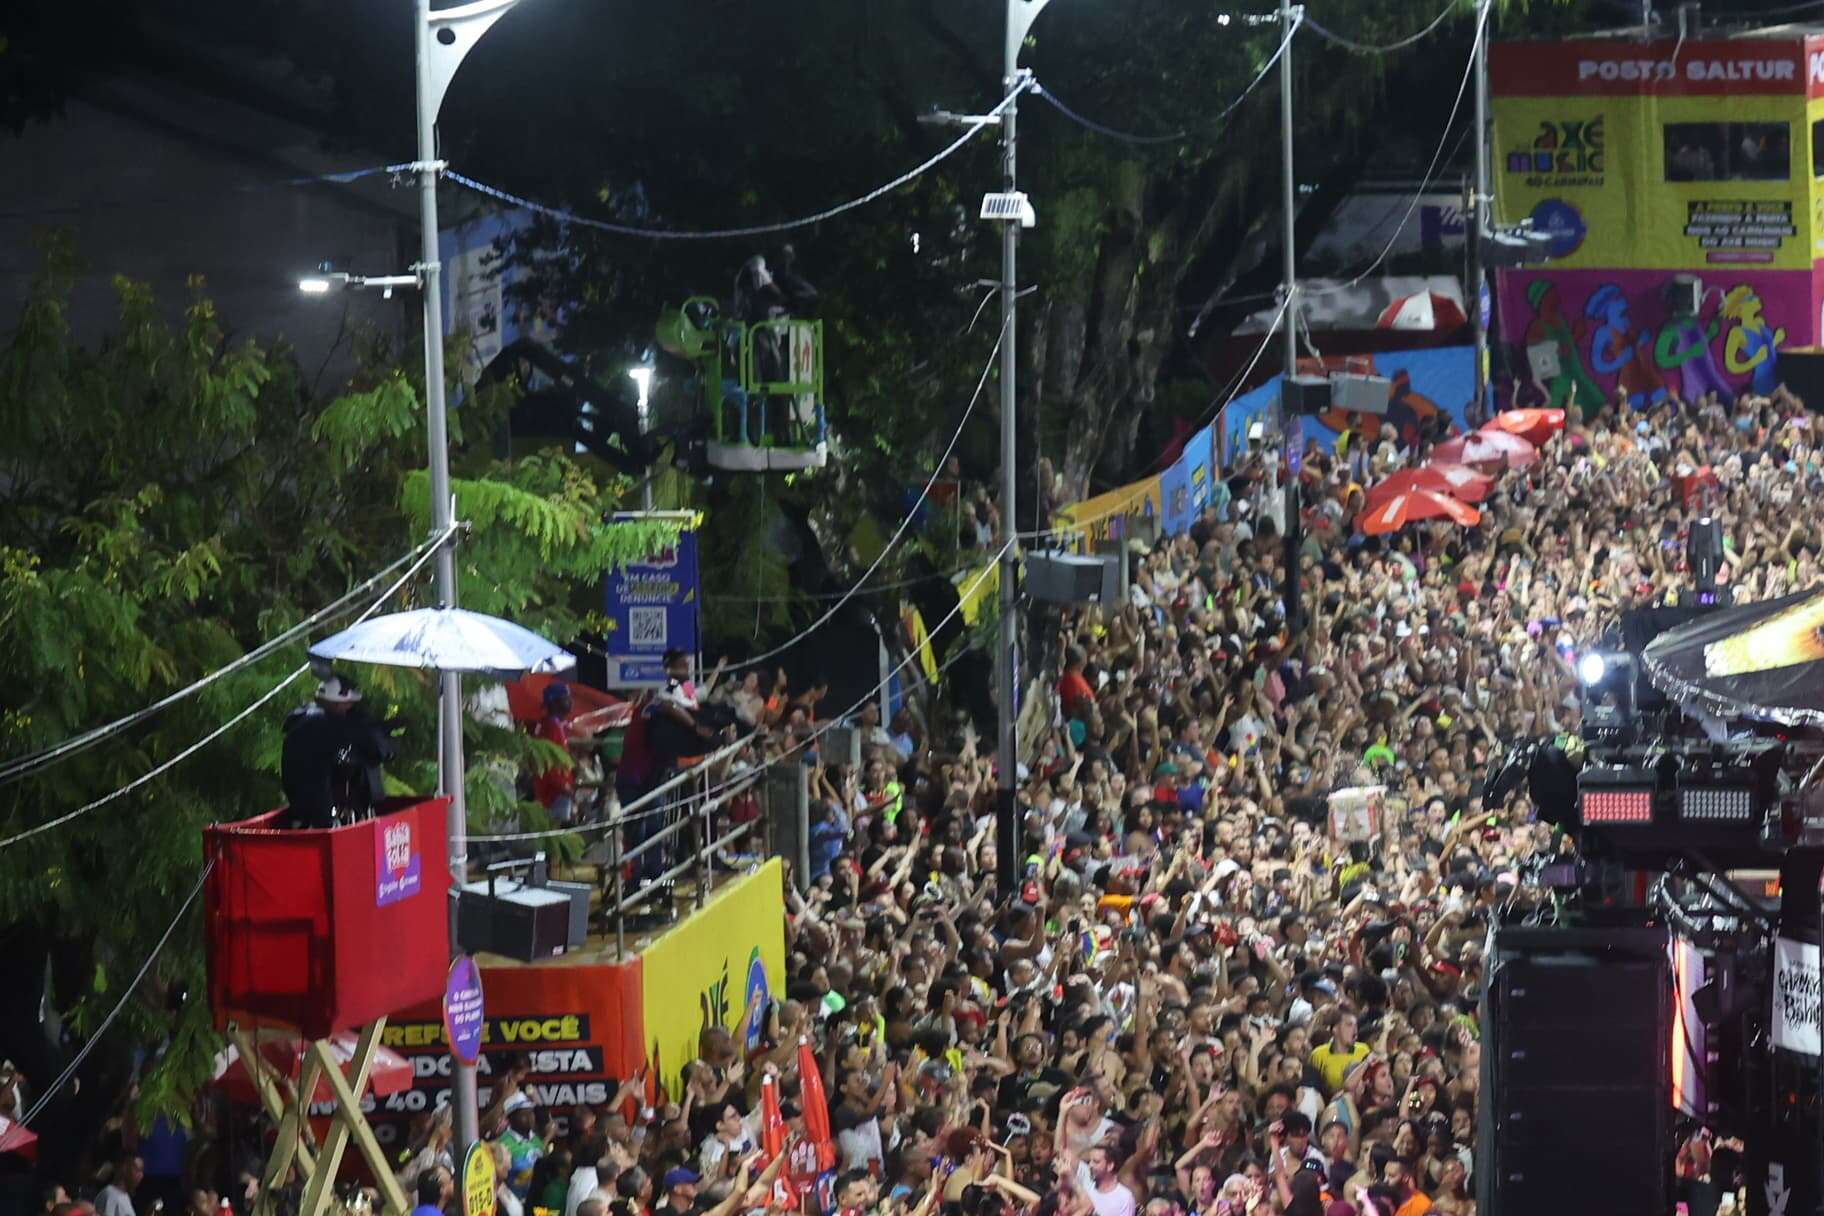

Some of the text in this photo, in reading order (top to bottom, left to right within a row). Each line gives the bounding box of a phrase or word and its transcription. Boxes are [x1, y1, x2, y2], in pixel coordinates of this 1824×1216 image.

[1579, 59, 1794, 80] POSTO SALTUR
[500, 1015, 580, 1042] VOCÊ
[385, 1091, 427, 1113] 40
